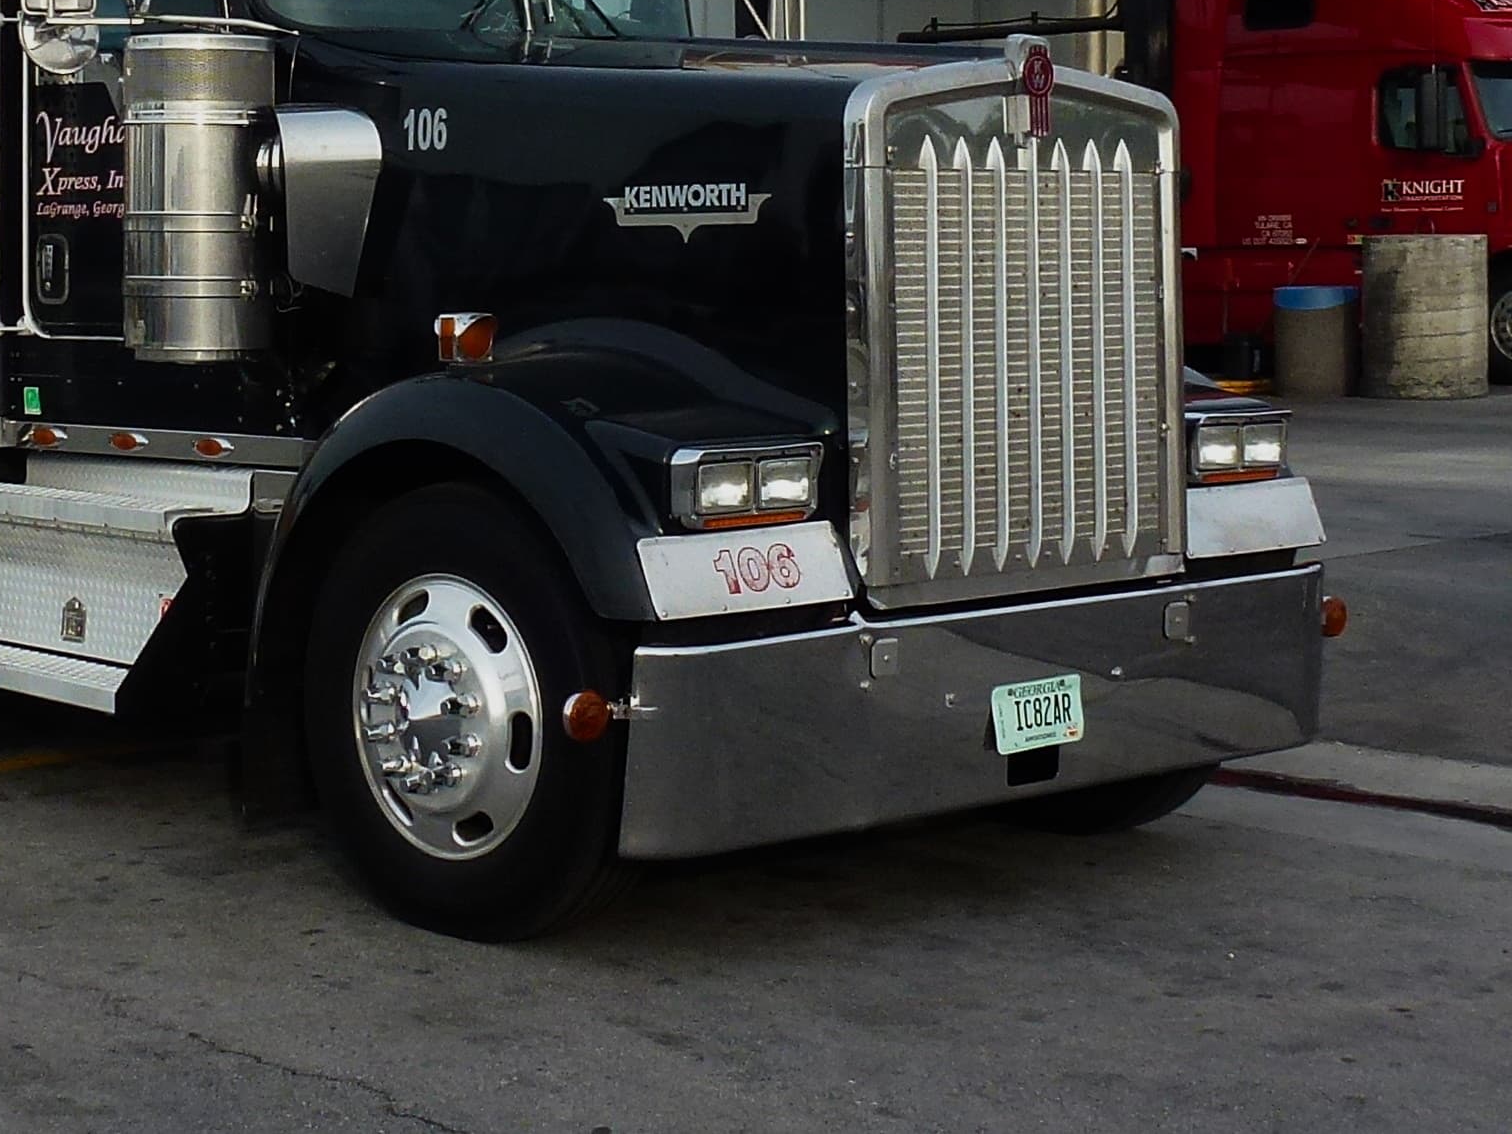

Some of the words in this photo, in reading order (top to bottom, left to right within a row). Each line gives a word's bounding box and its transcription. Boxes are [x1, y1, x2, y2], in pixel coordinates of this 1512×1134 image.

[403, 107, 448, 151] 106
[35, 167, 102, 196] Xpress,
[624, 183, 746, 209] KENWORTH
[1402, 179, 1465, 195] KNIGHT
[713, 543, 801, 595] 106
[1014, 680, 1062, 699] GEORGIA
[1014, 692, 1072, 732] IC82AR
